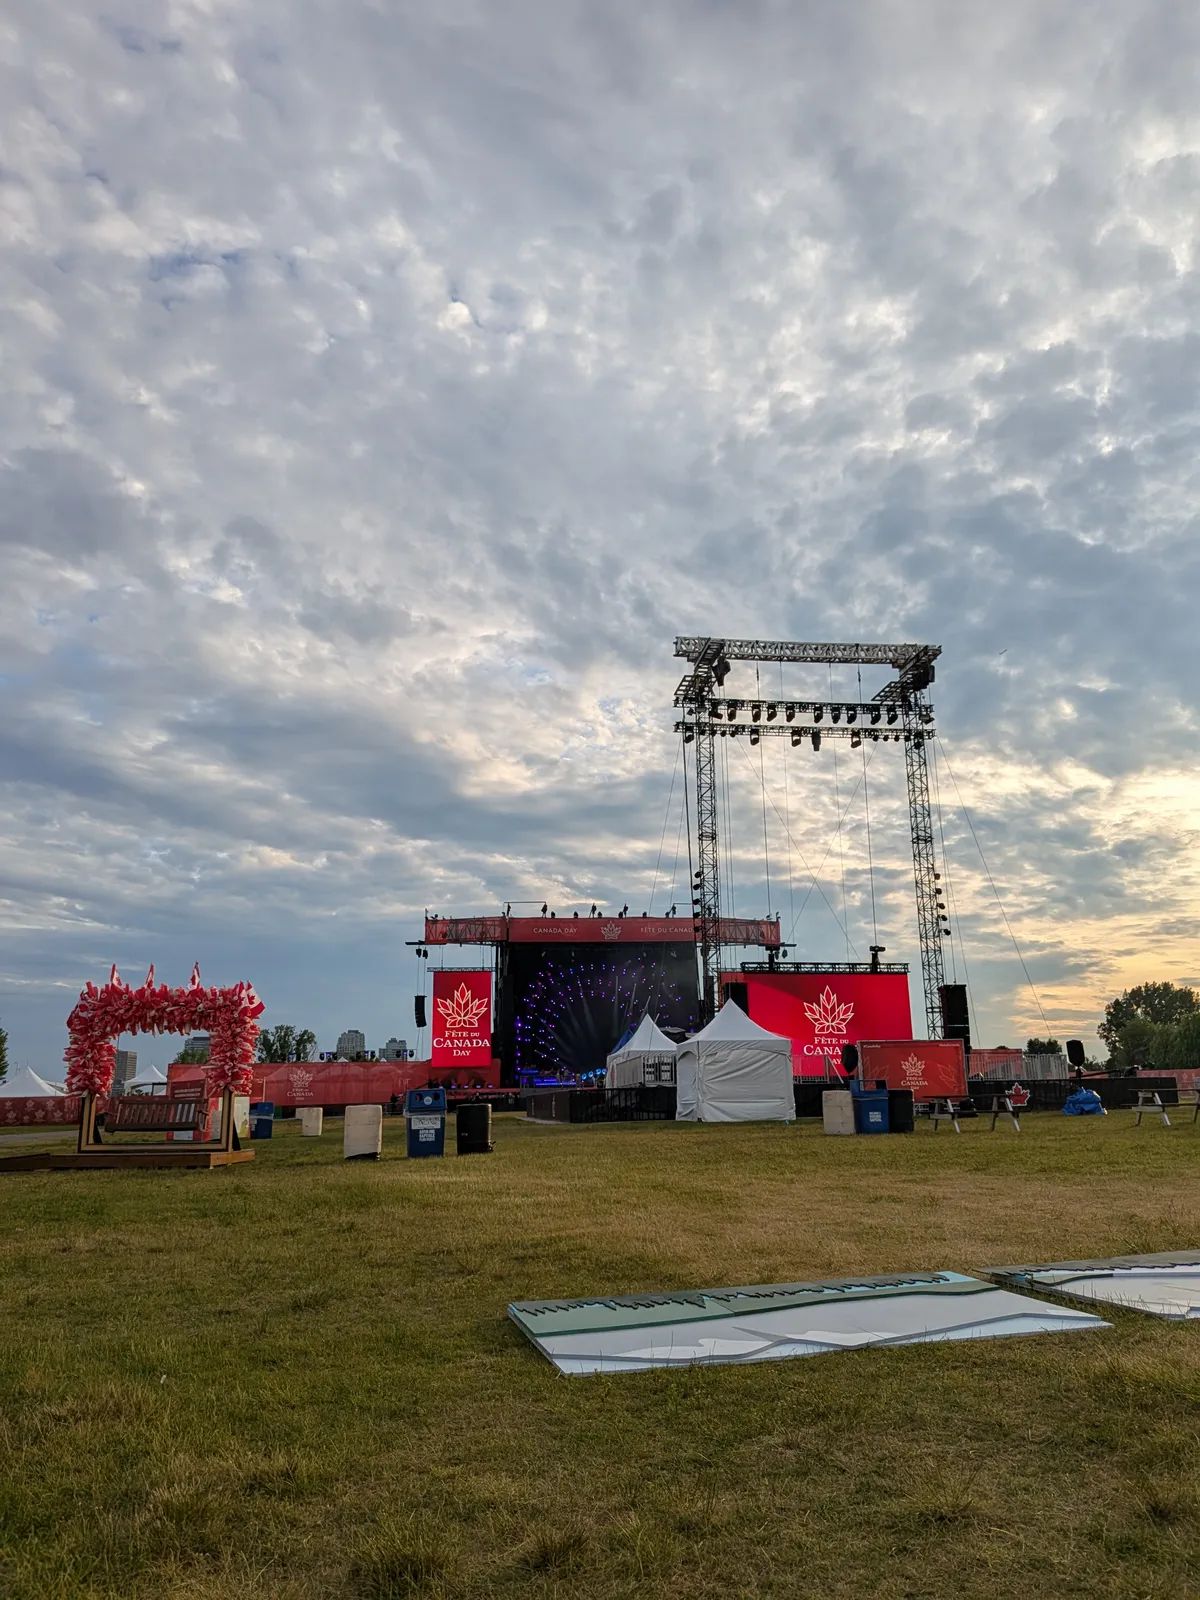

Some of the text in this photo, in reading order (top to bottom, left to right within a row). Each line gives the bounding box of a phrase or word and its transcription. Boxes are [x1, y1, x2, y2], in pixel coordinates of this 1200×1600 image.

[445, 1030, 469, 1038] FÊTE
[433, 1037, 491, 1048] CANADA
[814, 1036, 838, 1044] FÊTE
[452, 1049, 471, 1057] DAY
[803, 1044, 842, 1056] CANA
